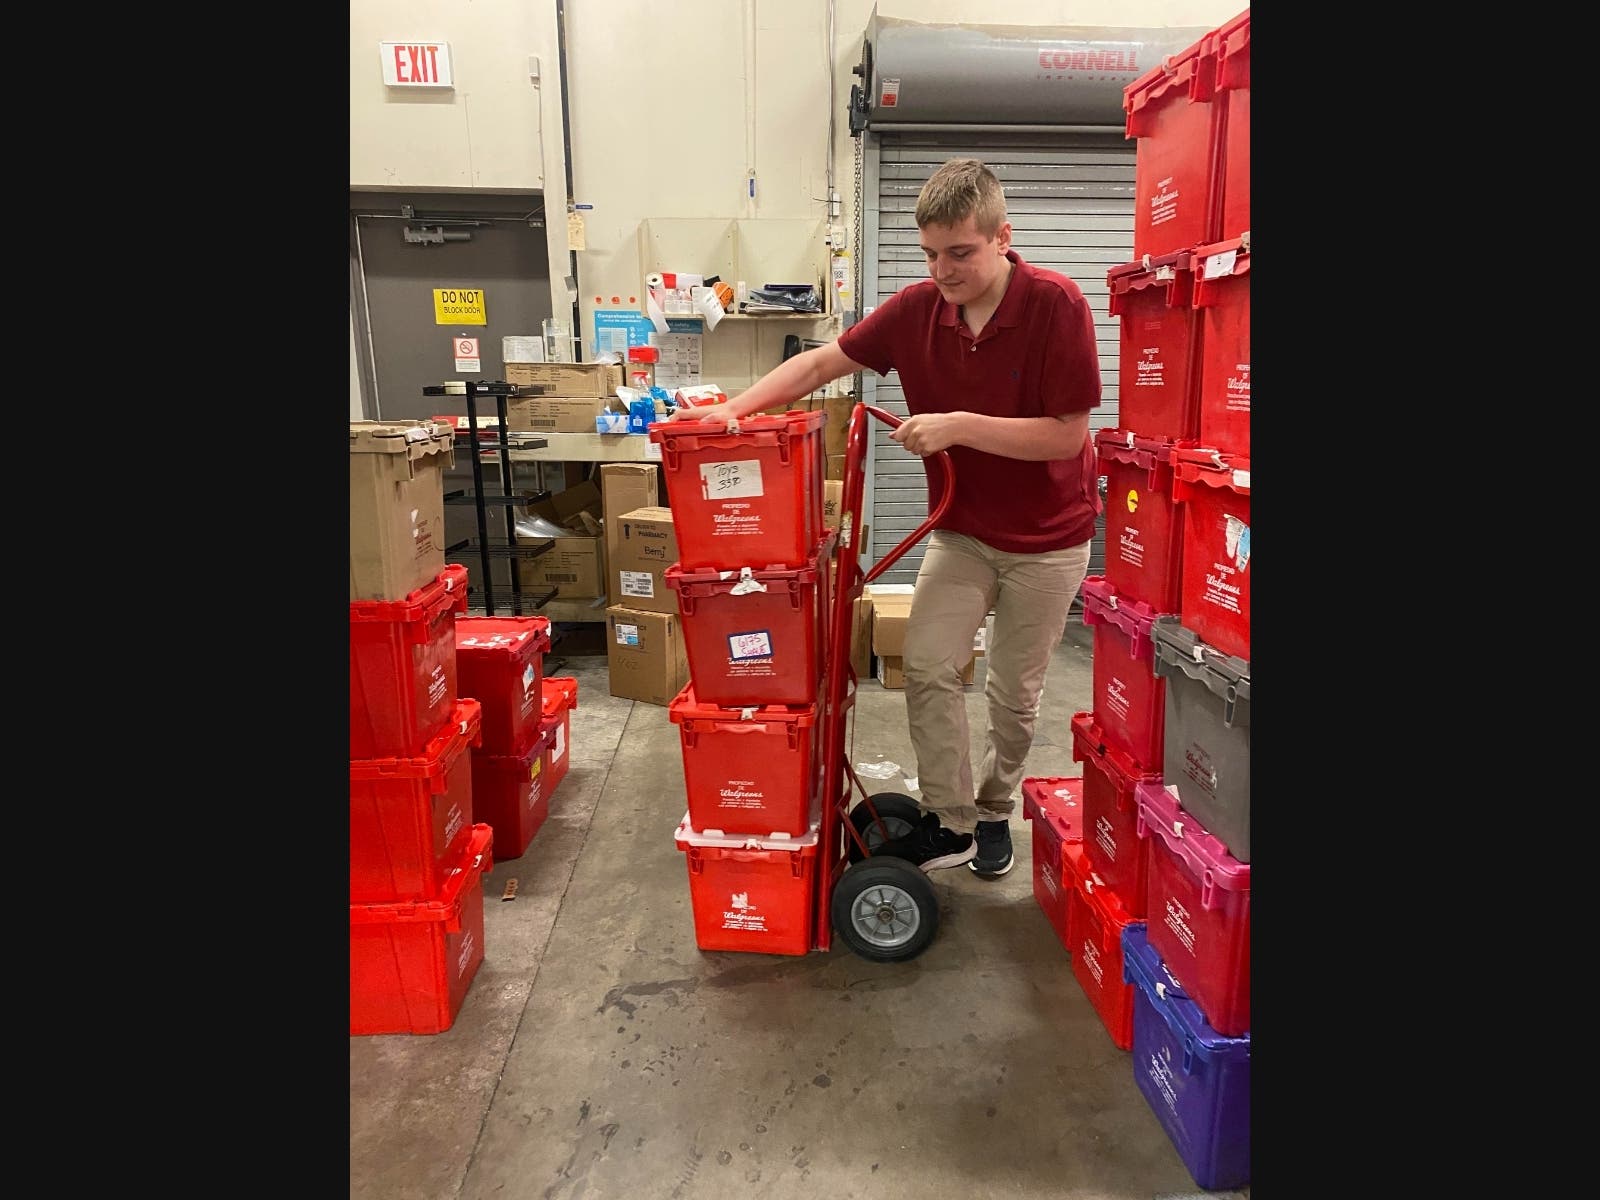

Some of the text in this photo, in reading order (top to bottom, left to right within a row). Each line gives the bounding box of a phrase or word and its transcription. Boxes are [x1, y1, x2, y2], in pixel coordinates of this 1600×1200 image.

[394, 46, 438, 82] EXIT
[1040, 50, 1139, 71] CORNELL
[442, 291, 479, 303] DO NOT
[1137, 361, 1164, 373] Walgreens
[713, 464, 739, 476] Toys
[713, 514, 762, 524] Walgreens
[644, 546, 666, 559] Berry
[1206, 574, 1241, 595] Walgreens
[1107, 683, 1130, 708] Walgreens
[720, 789, 764, 799] Walgreens
[723, 911, 766, 922] Walgreens
[1166, 900, 1196, 942] Walgreens
